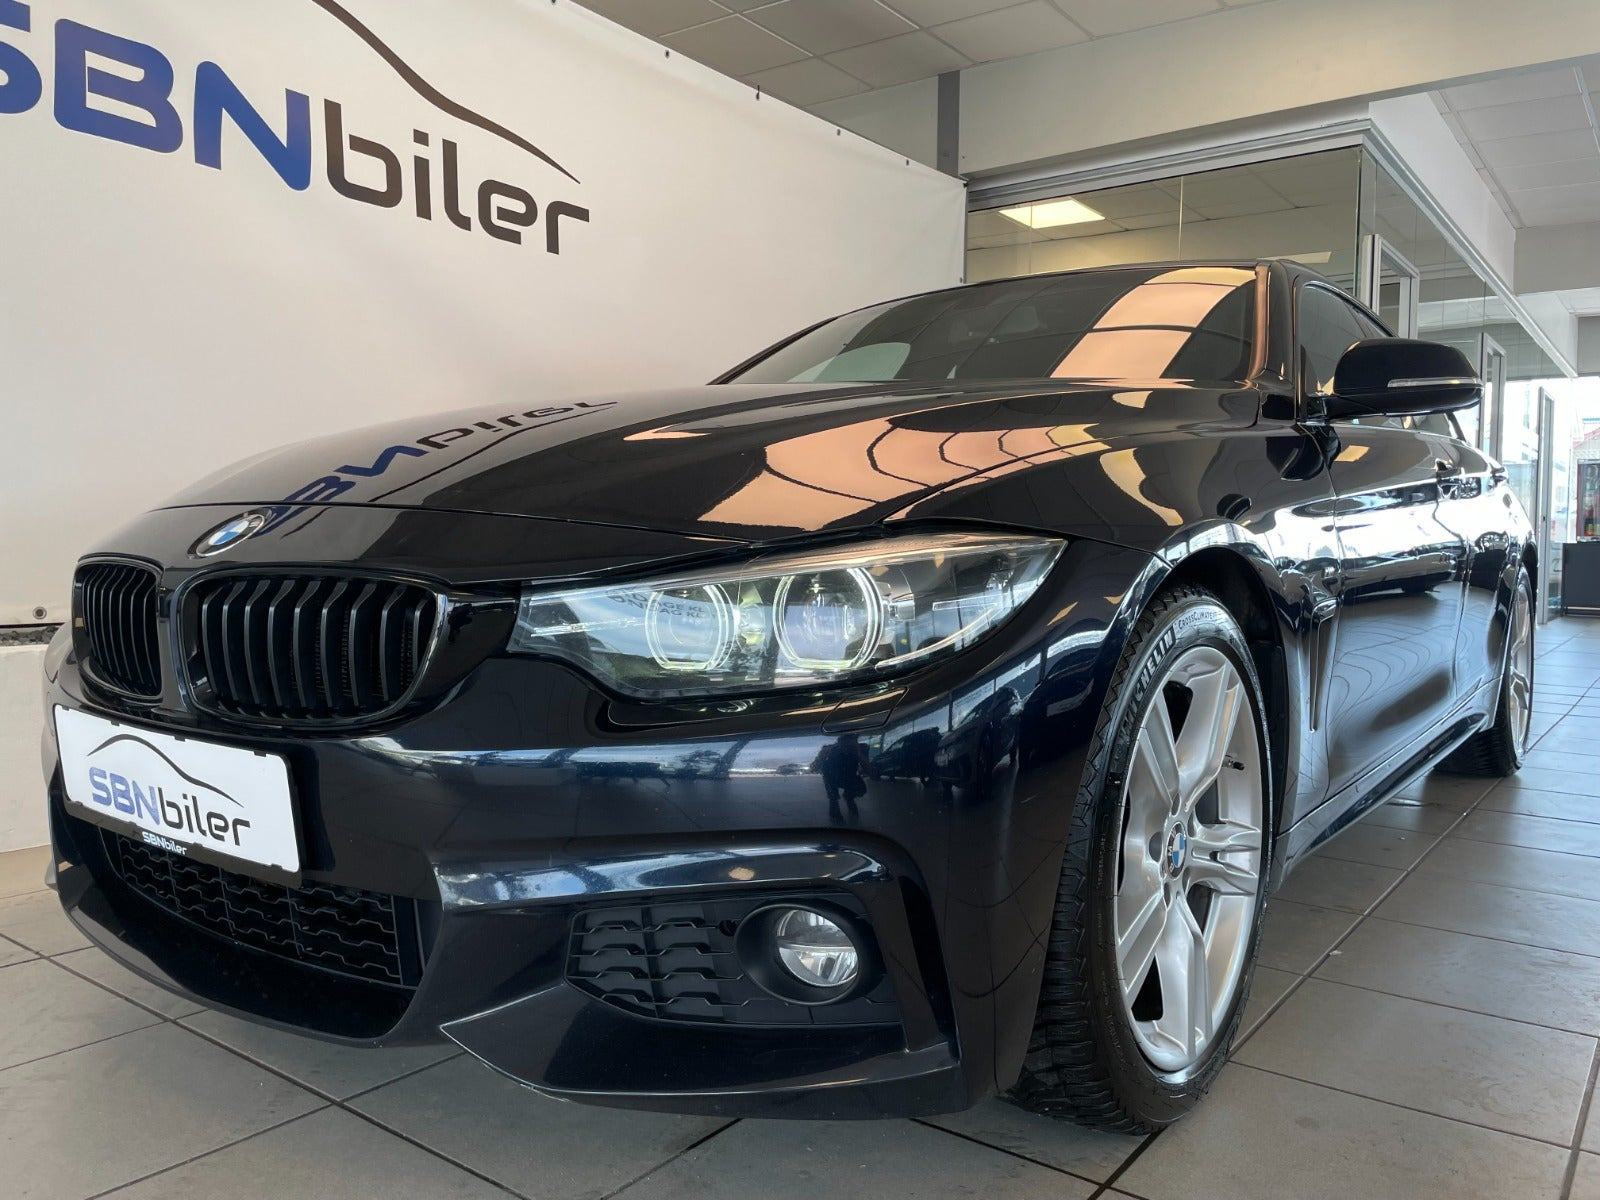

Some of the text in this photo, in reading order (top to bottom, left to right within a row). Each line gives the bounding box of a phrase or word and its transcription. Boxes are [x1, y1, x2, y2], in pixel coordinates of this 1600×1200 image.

[1119, 629, 1176, 740] MICHELIN
[89, 766, 250, 846] SBNbiler
[142, 831, 187, 855] SBNbiler
